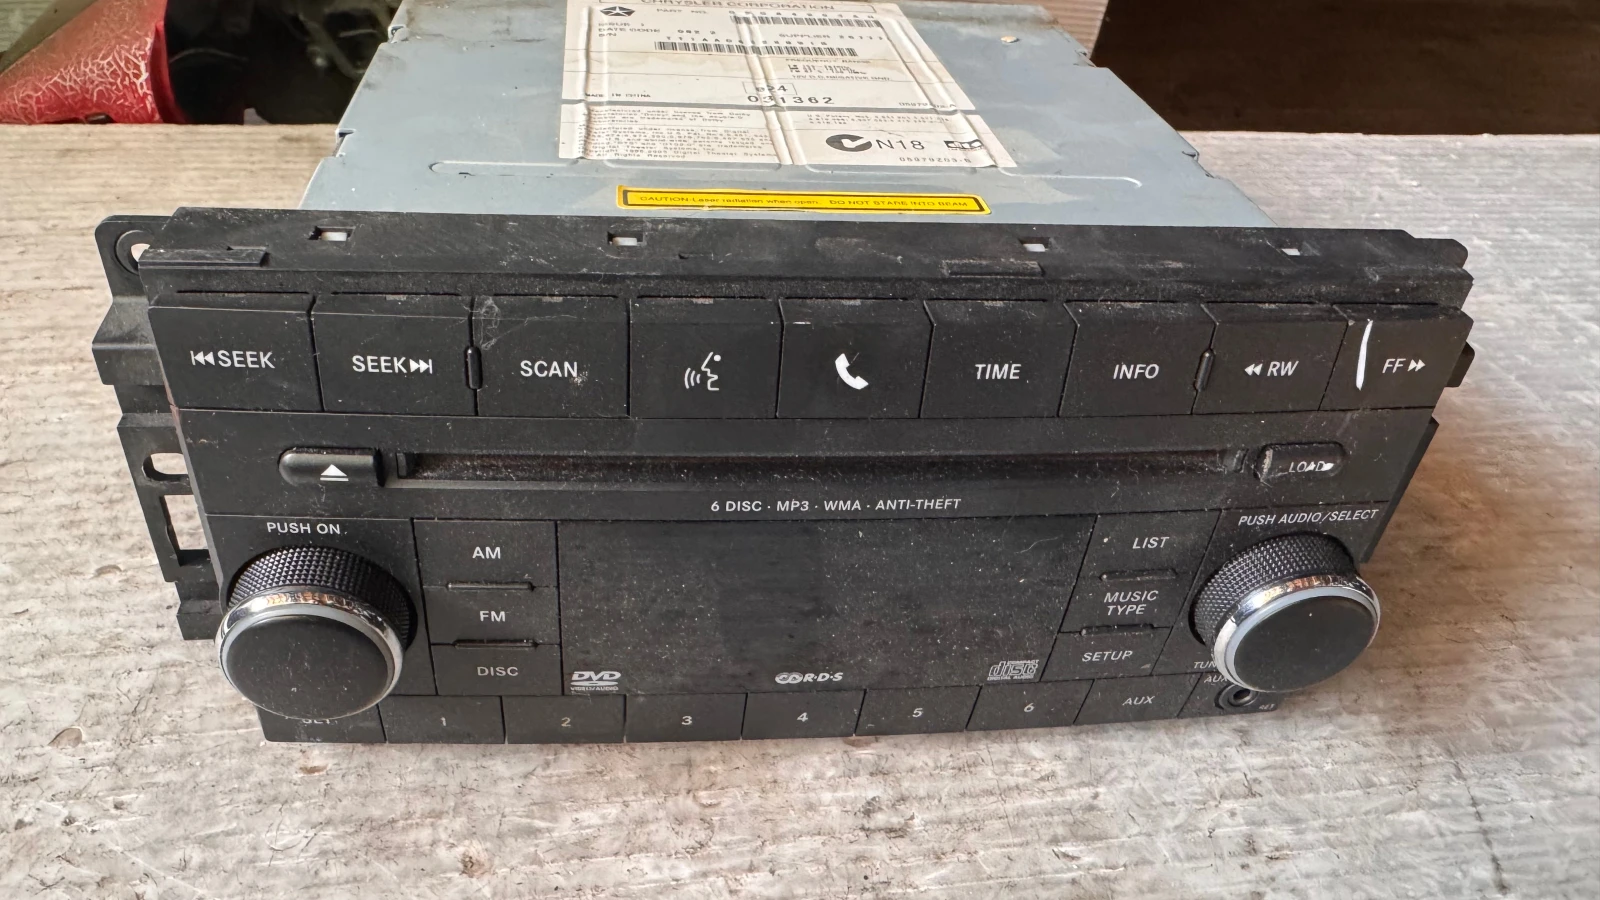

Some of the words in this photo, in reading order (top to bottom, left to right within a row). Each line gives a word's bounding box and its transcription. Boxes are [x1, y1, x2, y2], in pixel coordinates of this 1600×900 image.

[747, 95, 835, 105] 031362
[875, 139, 925, 151] N18
[218, 350, 275, 369] SEEK
[352, 355, 407, 373] SEEK
[1383, 358, 1406, 373] FF
[520, 360, 578, 378] SCAN
[975, 363, 1021, 380] TIME
[1113, 363, 1160, 380] INFO
[1267, 360, 1299, 376] RW
[1288, 460, 1326, 473] LOAD
[711, 500, 720, 512] 6
[725, 500, 762, 512] DISC
[776, 500, 809, 512] MP3
[824, 499, 862, 511] WMA
[875, 498, 962, 511] ANTI-THEFT
[1238, 513, 1277, 526] PUSH
[1279, 509, 1380, 524] AUDIO/SELECT
[266, 521, 311, 534] PUSH
[316, 523, 341, 535] ON
[1132, 536, 1170, 549] LIST
[472, 546, 501, 560] AM
[1103, 589, 1159, 604] MUSIC
[479, 610, 506, 622] FM
[1107, 604, 1147, 616] TYPE
[1081, 650, 1133, 662] SETUP
[477, 666, 519, 677] DISC
[571, 670, 622, 681] DVD
[1122, 695, 1156, 706] AUX
[912, 707, 923, 718] 5
[1024, 702, 1034, 713] 6
[440, 716, 447, 727] 1
[561, 716, 572, 727] 2
[681, 715, 693, 726] 3
[796, 712, 808, 722] 4
